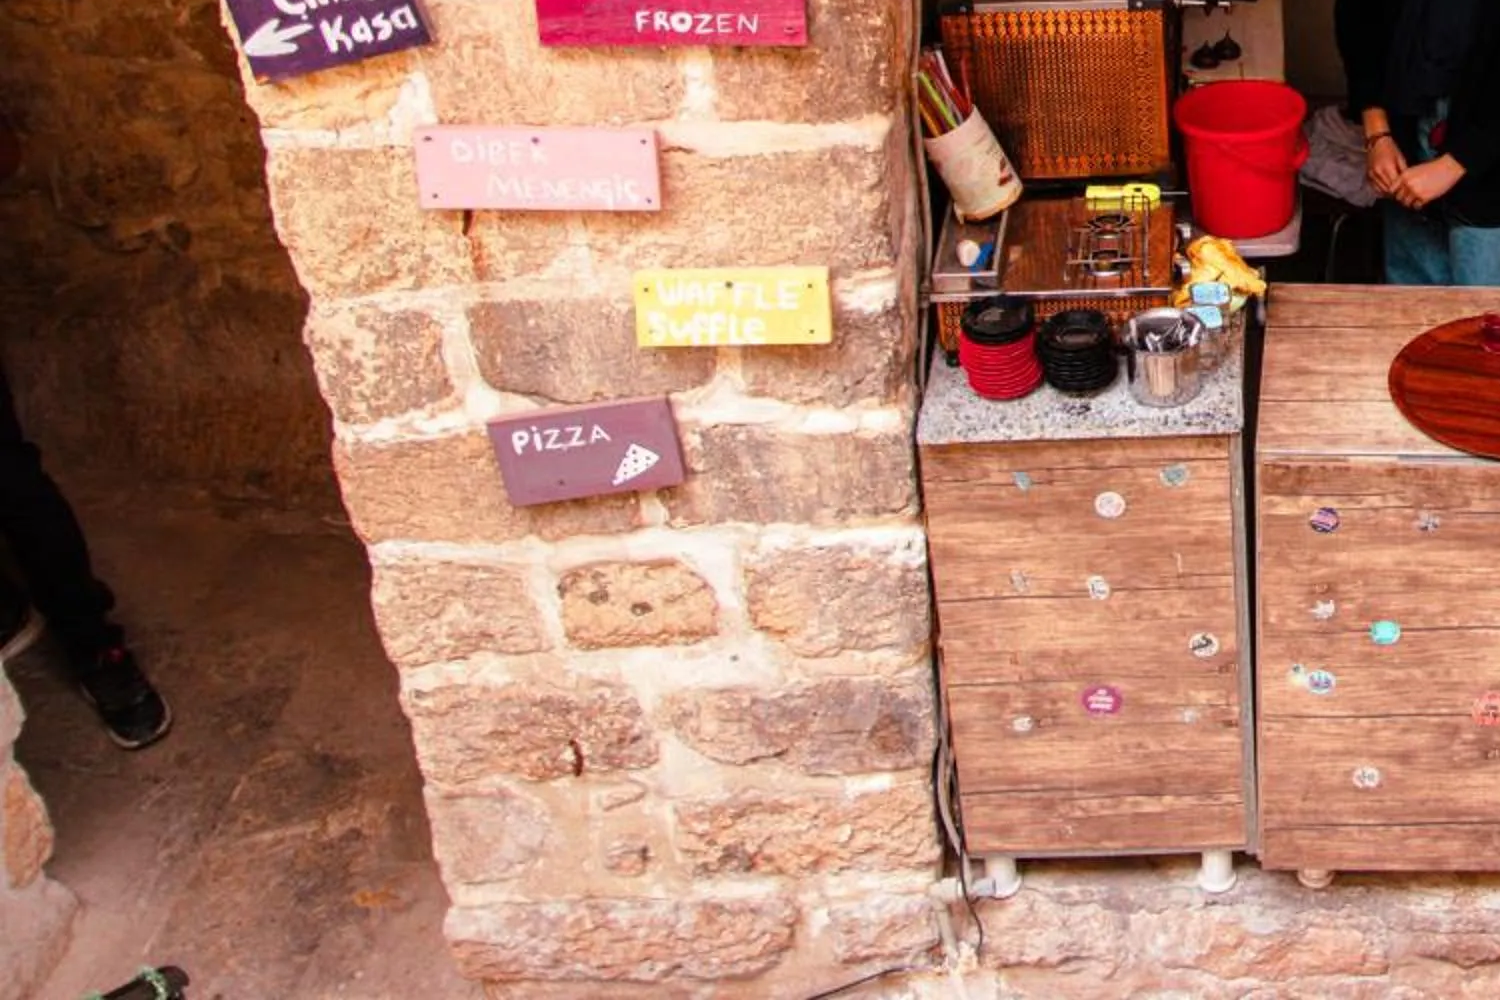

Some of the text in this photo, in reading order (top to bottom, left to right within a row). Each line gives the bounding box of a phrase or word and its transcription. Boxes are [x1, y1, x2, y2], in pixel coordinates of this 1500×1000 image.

[319, 4, 418, 53] Kasa
[635, 10, 758, 34] FROZEN
[655, 279, 801, 310] WAFFLE
